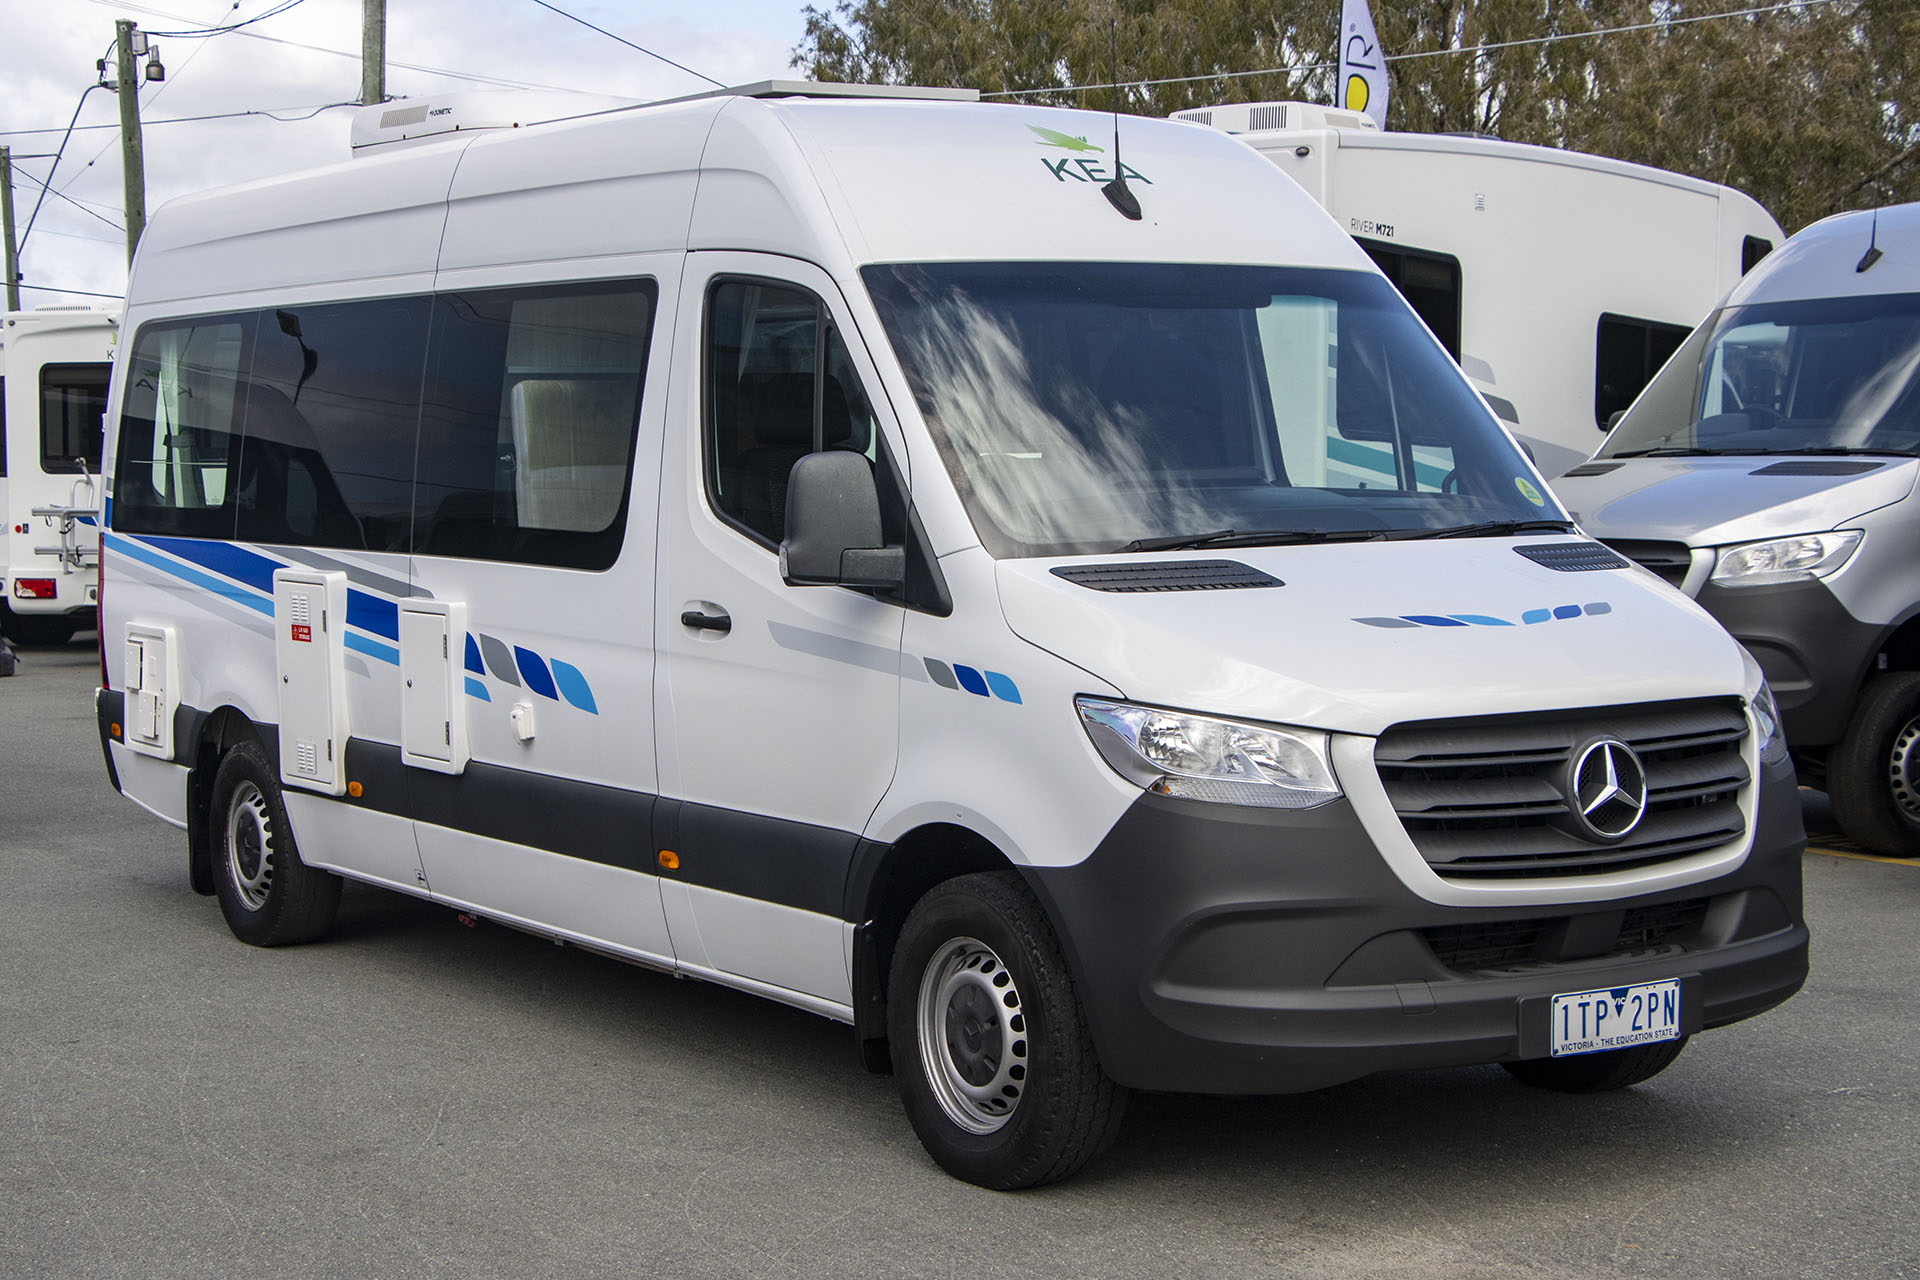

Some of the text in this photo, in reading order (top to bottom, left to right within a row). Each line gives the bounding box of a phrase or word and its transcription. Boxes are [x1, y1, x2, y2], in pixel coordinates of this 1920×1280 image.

[1040, 158, 1153, 184] KEA
[1350, 217, 1394, 237] RIVER M721
[1561, 989, 1675, 1041] 1TP 2PN
[1560, 1040, 1594, 1052] VICTORIA
[1601, 1037, 1615, 1046] THE
[1616, 1032, 1654, 1044] EDUCATION
[1654, 1028, 1673, 1038] STATE
